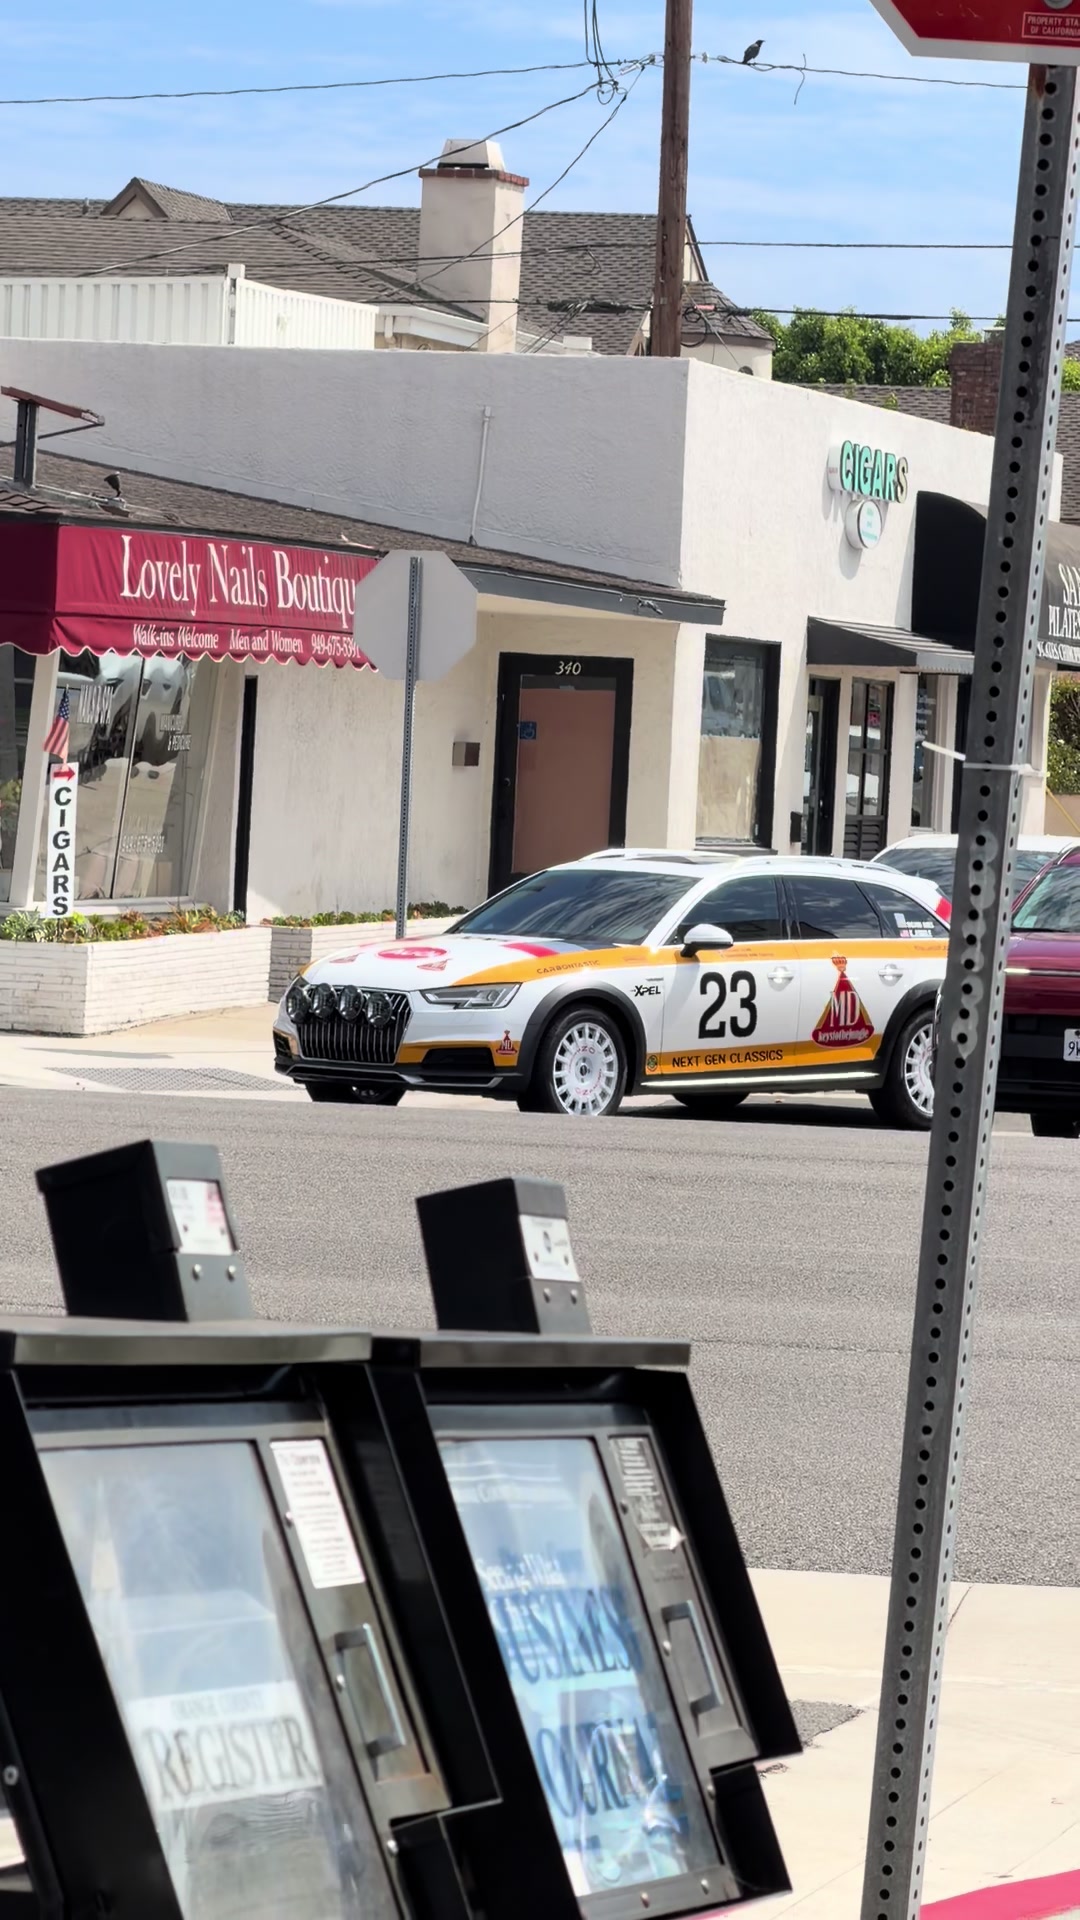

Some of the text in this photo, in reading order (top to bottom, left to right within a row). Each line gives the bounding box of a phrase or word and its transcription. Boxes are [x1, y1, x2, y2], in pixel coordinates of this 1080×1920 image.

[1027, 15, 1080, 27] PROPERTY STA
[1030, 26, 1039, 35] OF
[840, 439, 909, 504] CIGARS
[119, 534, 356, 629] Lovely Nails Boutiqu
[132, 623, 175, 647] Walk-ins
[176, 625, 219, 650] Welcome
[229, 628, 250, 651] Men
[251, 629, 269, 652] and
[270, 630, 304, 654] Women
[554, 660, 582, 676] 340
[51, 786, 73, 916] CIGARS
[536, 959, 601, 975] CARBONTASTIC
[698, 970, 758, 1040] 23
[829, 991, 862, 1028] MD
[671, 1049, 784, 1068] NEXT GEN CLASSICS
[142, 1715, 322, 1801] REGISTER
